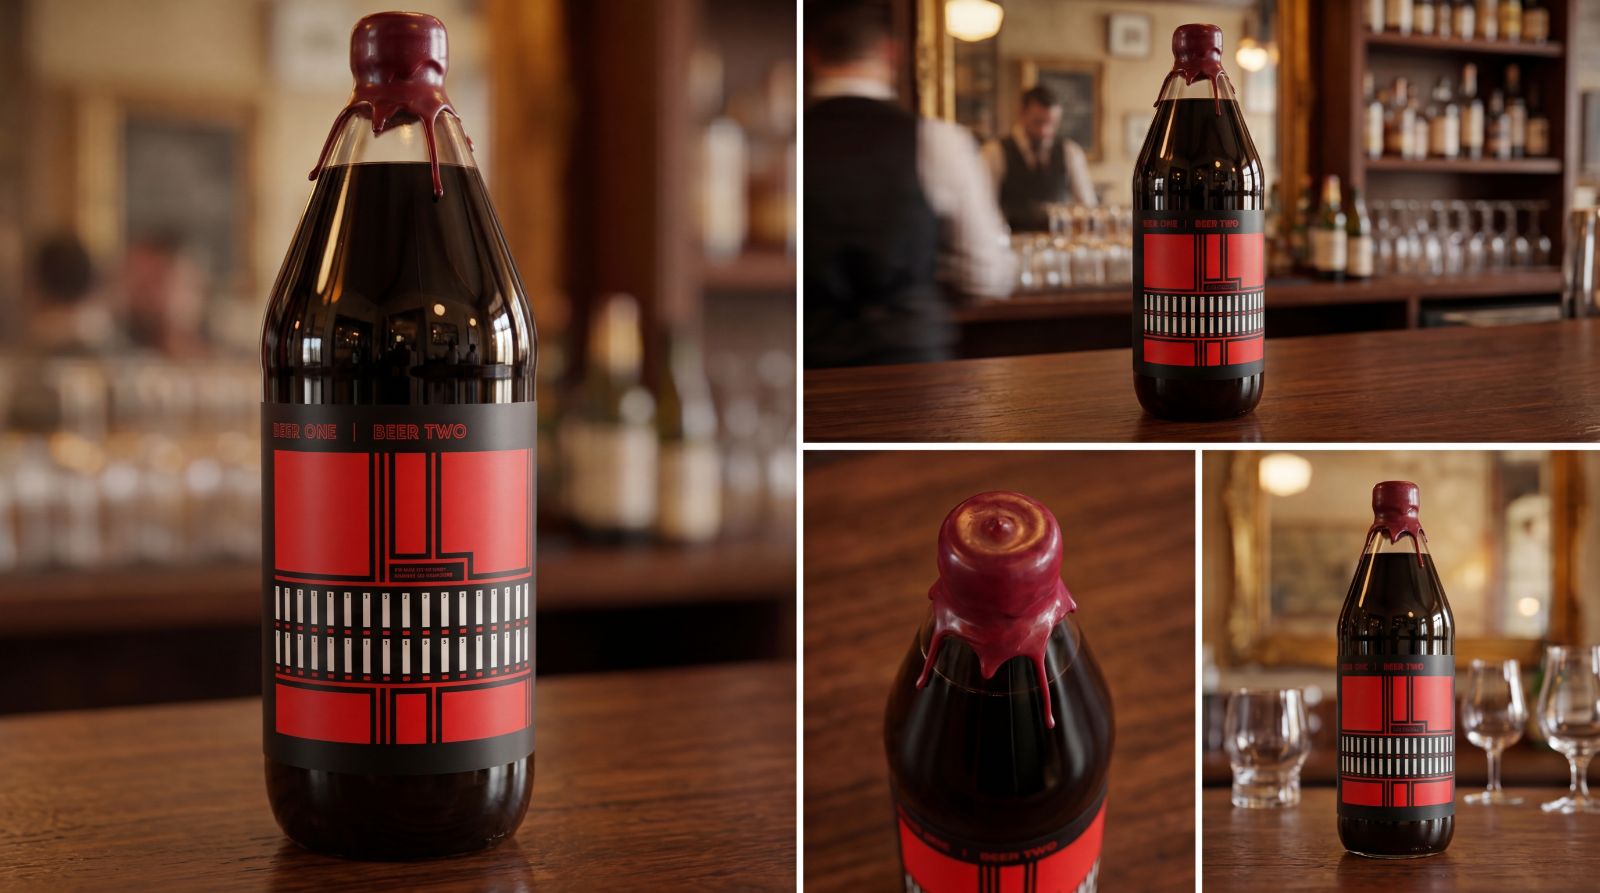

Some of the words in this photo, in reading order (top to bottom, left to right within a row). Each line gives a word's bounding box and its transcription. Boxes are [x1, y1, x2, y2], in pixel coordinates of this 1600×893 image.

[1195, 219, 1217, 228] BEER
[1220, 219, 1239, 228] TWO
[273, 423, 300, 438] BEER
[304, 424, 337, 440] ONE
[373, 424, 419, 440] BEER
[424, 424, 467, 440] TWO
[1023, 841, 1058, 859] TWO
